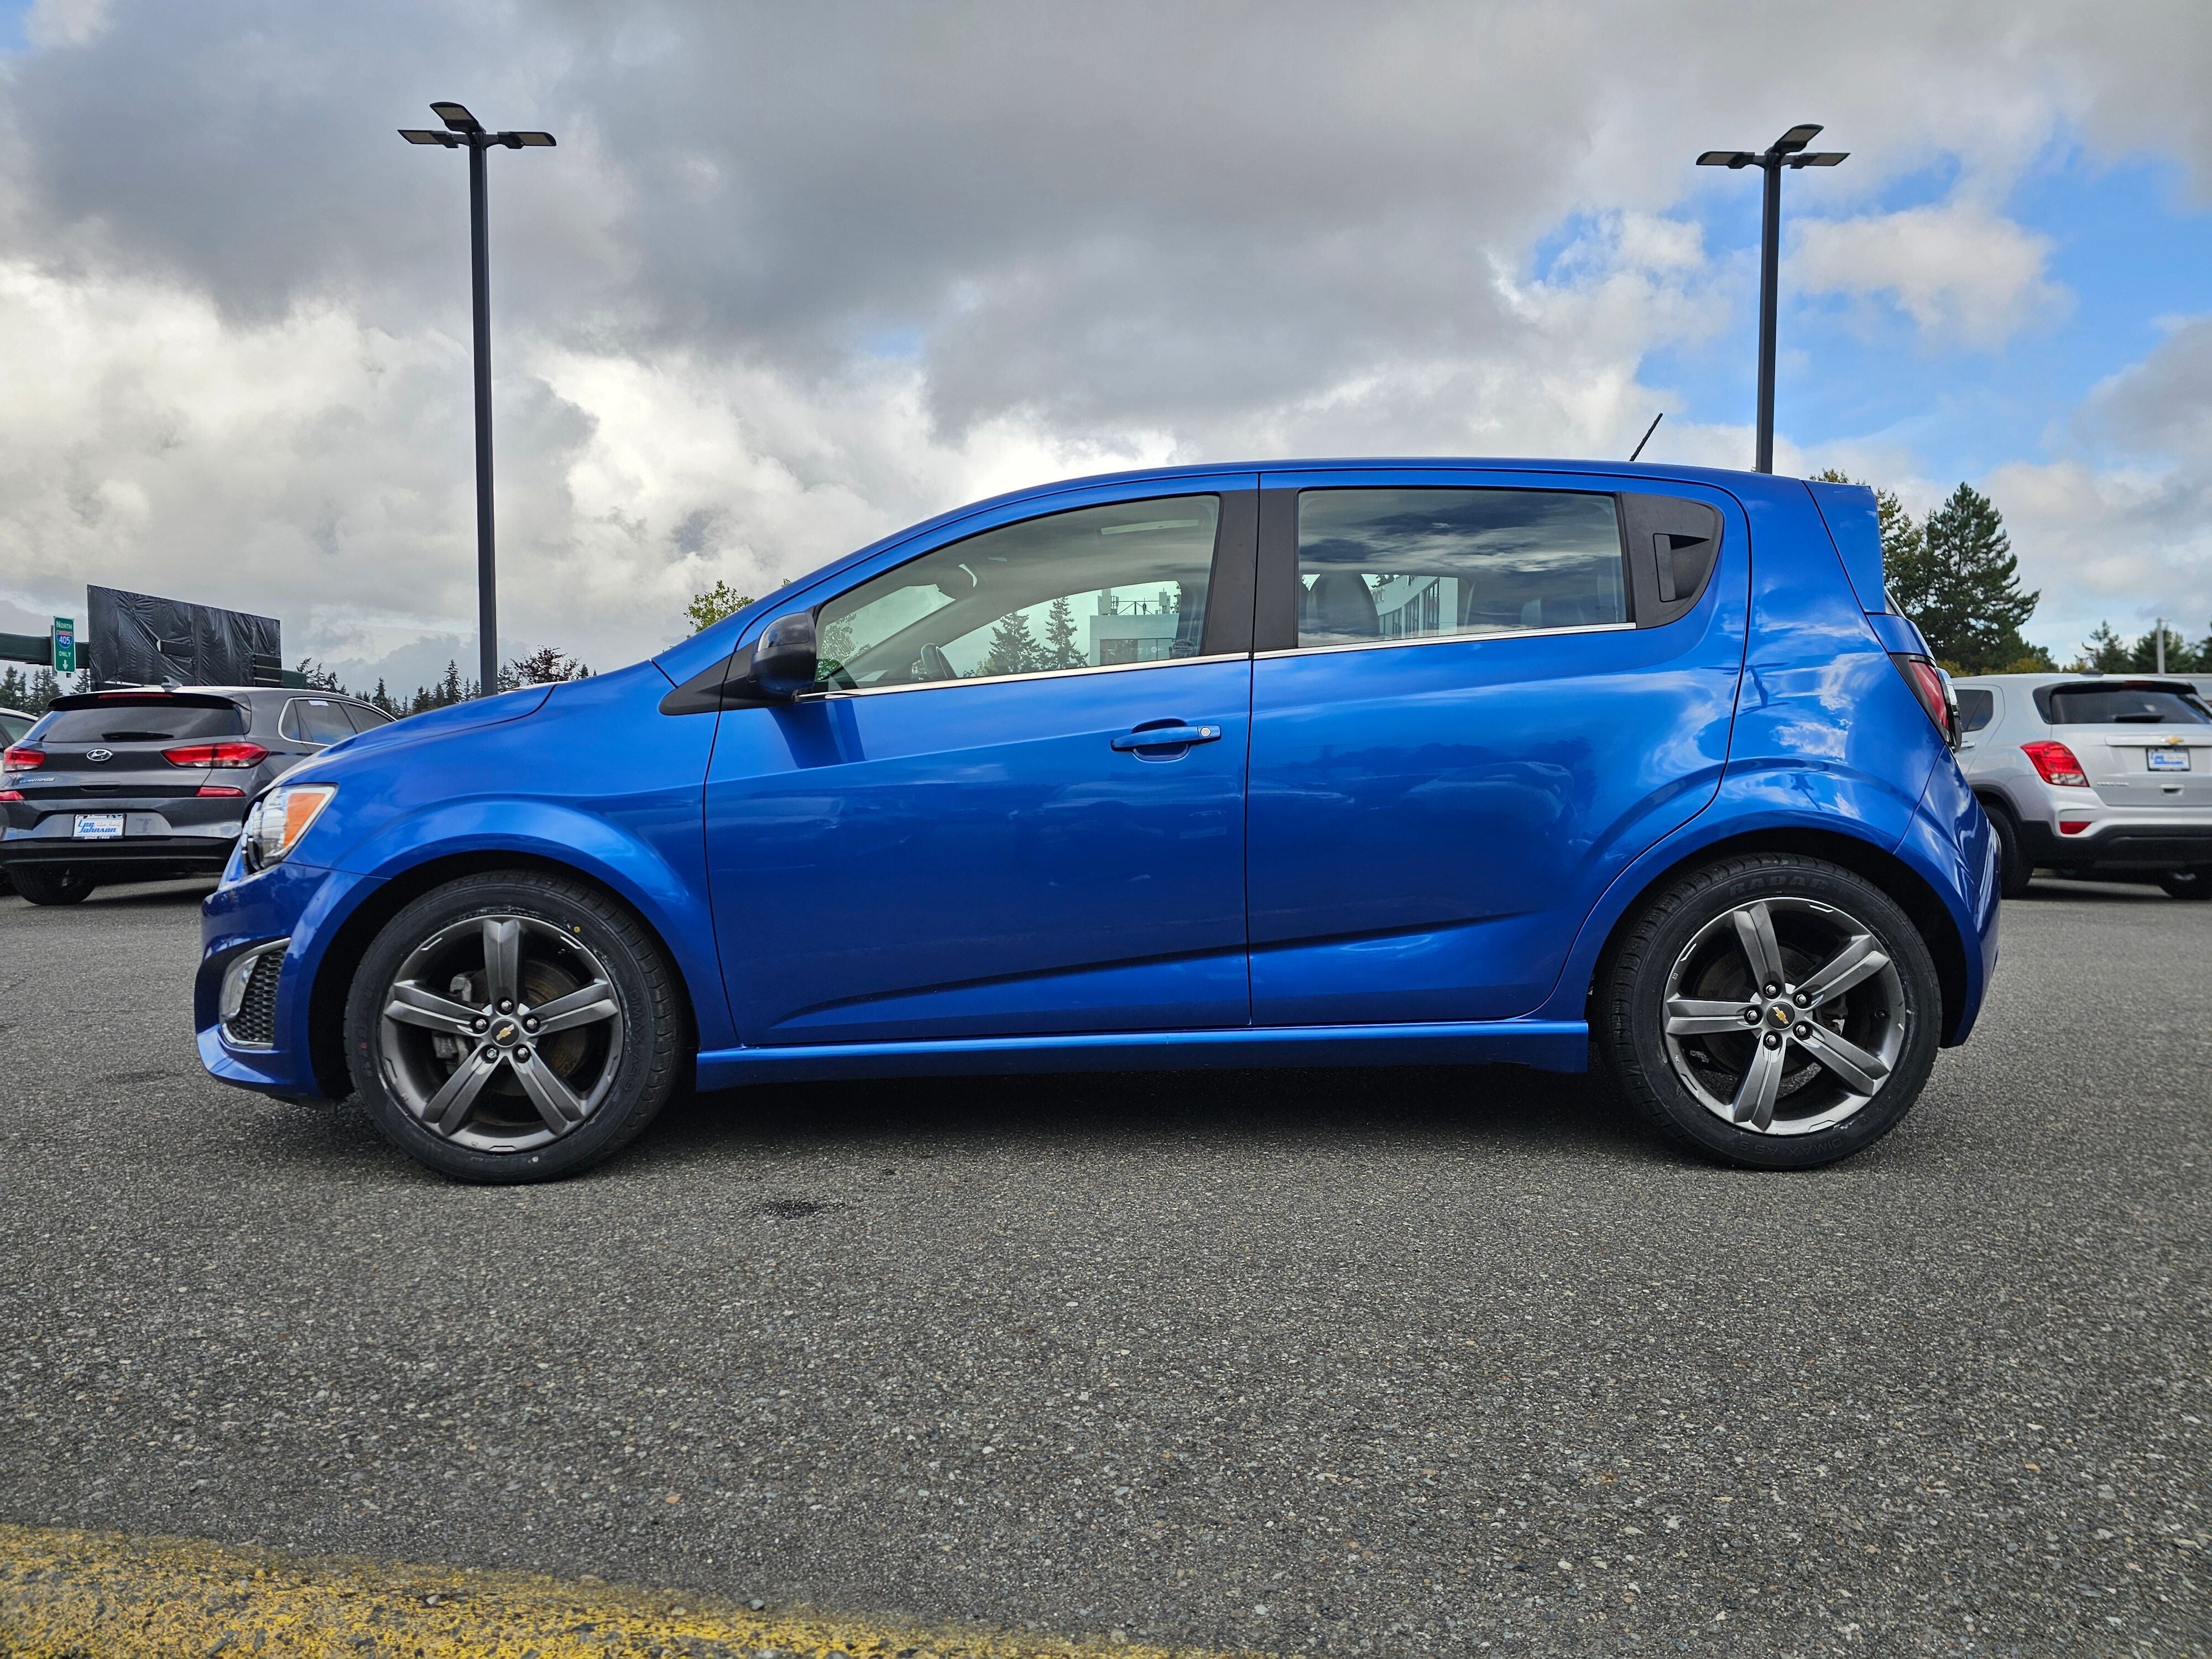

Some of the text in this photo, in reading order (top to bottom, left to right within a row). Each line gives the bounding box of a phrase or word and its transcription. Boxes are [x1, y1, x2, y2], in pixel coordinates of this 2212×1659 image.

[56, 620, 72, 629] NORTH
[59, 636, 70, 644] 405
[78, 825, 116, 833] Johnson
[1730, 876, 1828, 897] RADAR
[629, 990, 646, 1044] DIMAX
[1787, 1138, 1843, 1157] DIMAX
